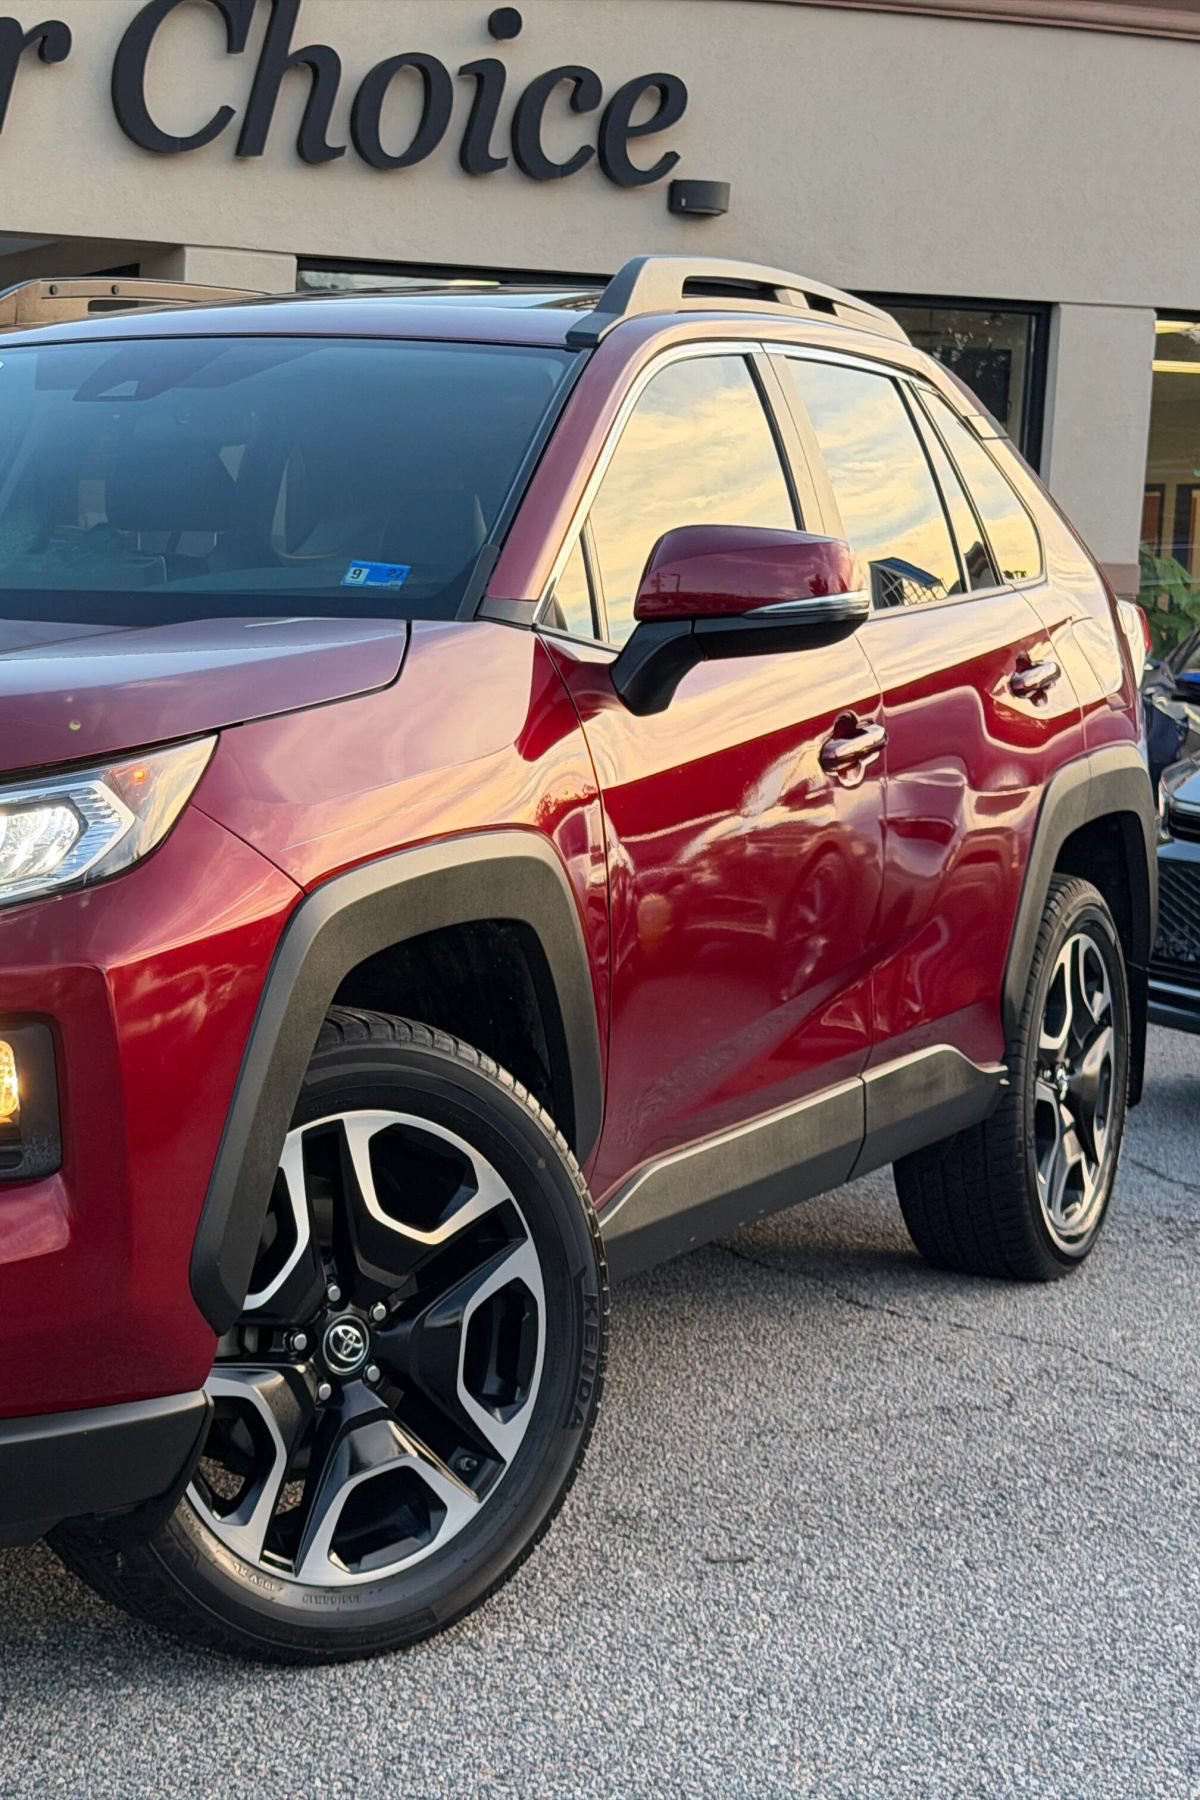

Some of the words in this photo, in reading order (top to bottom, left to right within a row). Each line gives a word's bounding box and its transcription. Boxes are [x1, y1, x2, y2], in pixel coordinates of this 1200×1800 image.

[111, 0, 689, 188] Choice
[351, 568, 363, 580] 9
[569, 1294, 599, 1430] KENDA
